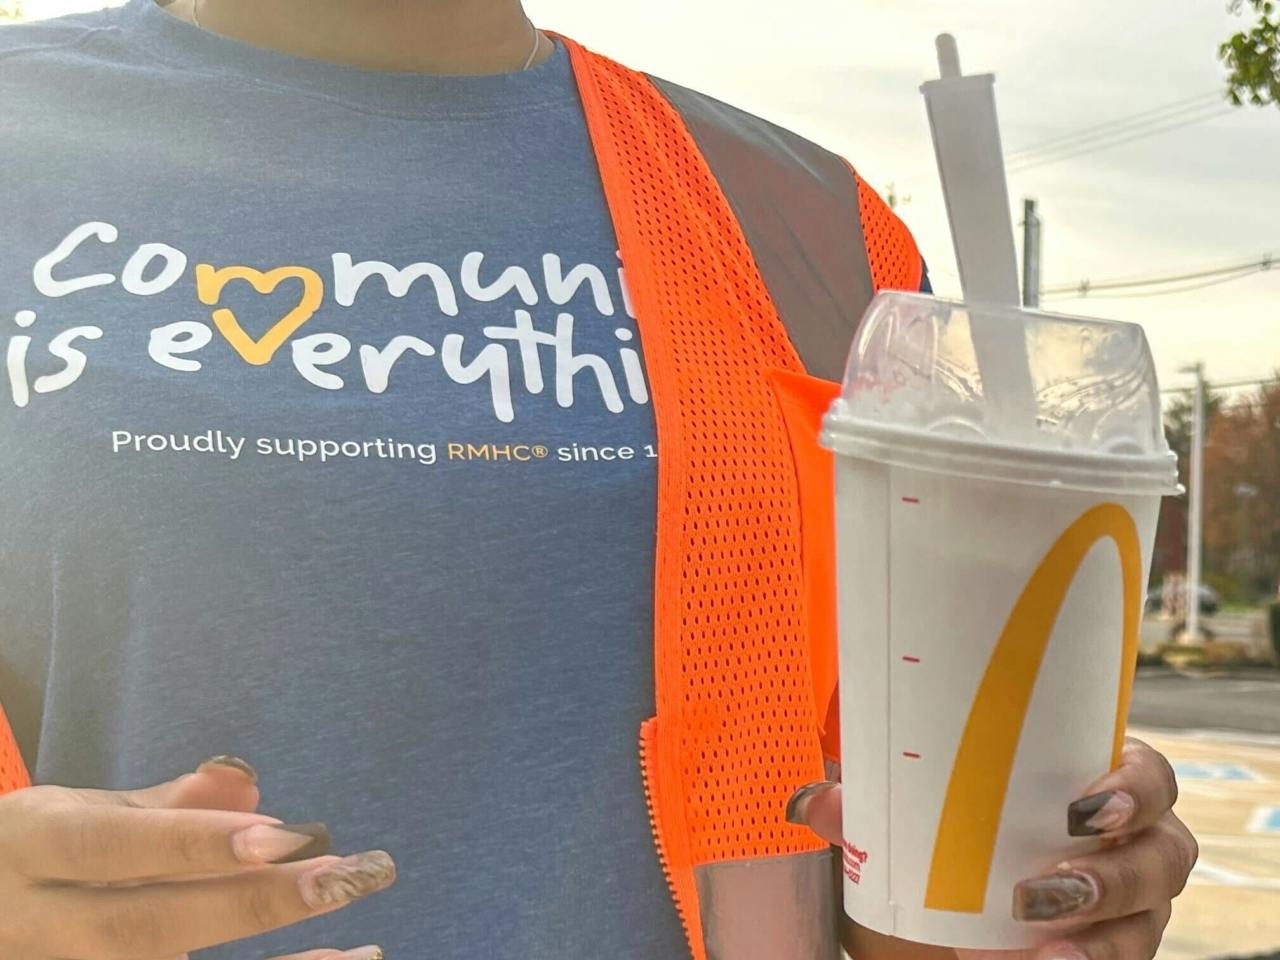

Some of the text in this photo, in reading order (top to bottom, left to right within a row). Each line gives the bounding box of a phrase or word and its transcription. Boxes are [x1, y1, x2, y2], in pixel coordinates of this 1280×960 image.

[6, 310, 103, 407] is
[112, 430, 246, 460] Proudly
[256, 437, 437, 465] supporting
[557, 442, 635, 462] since
